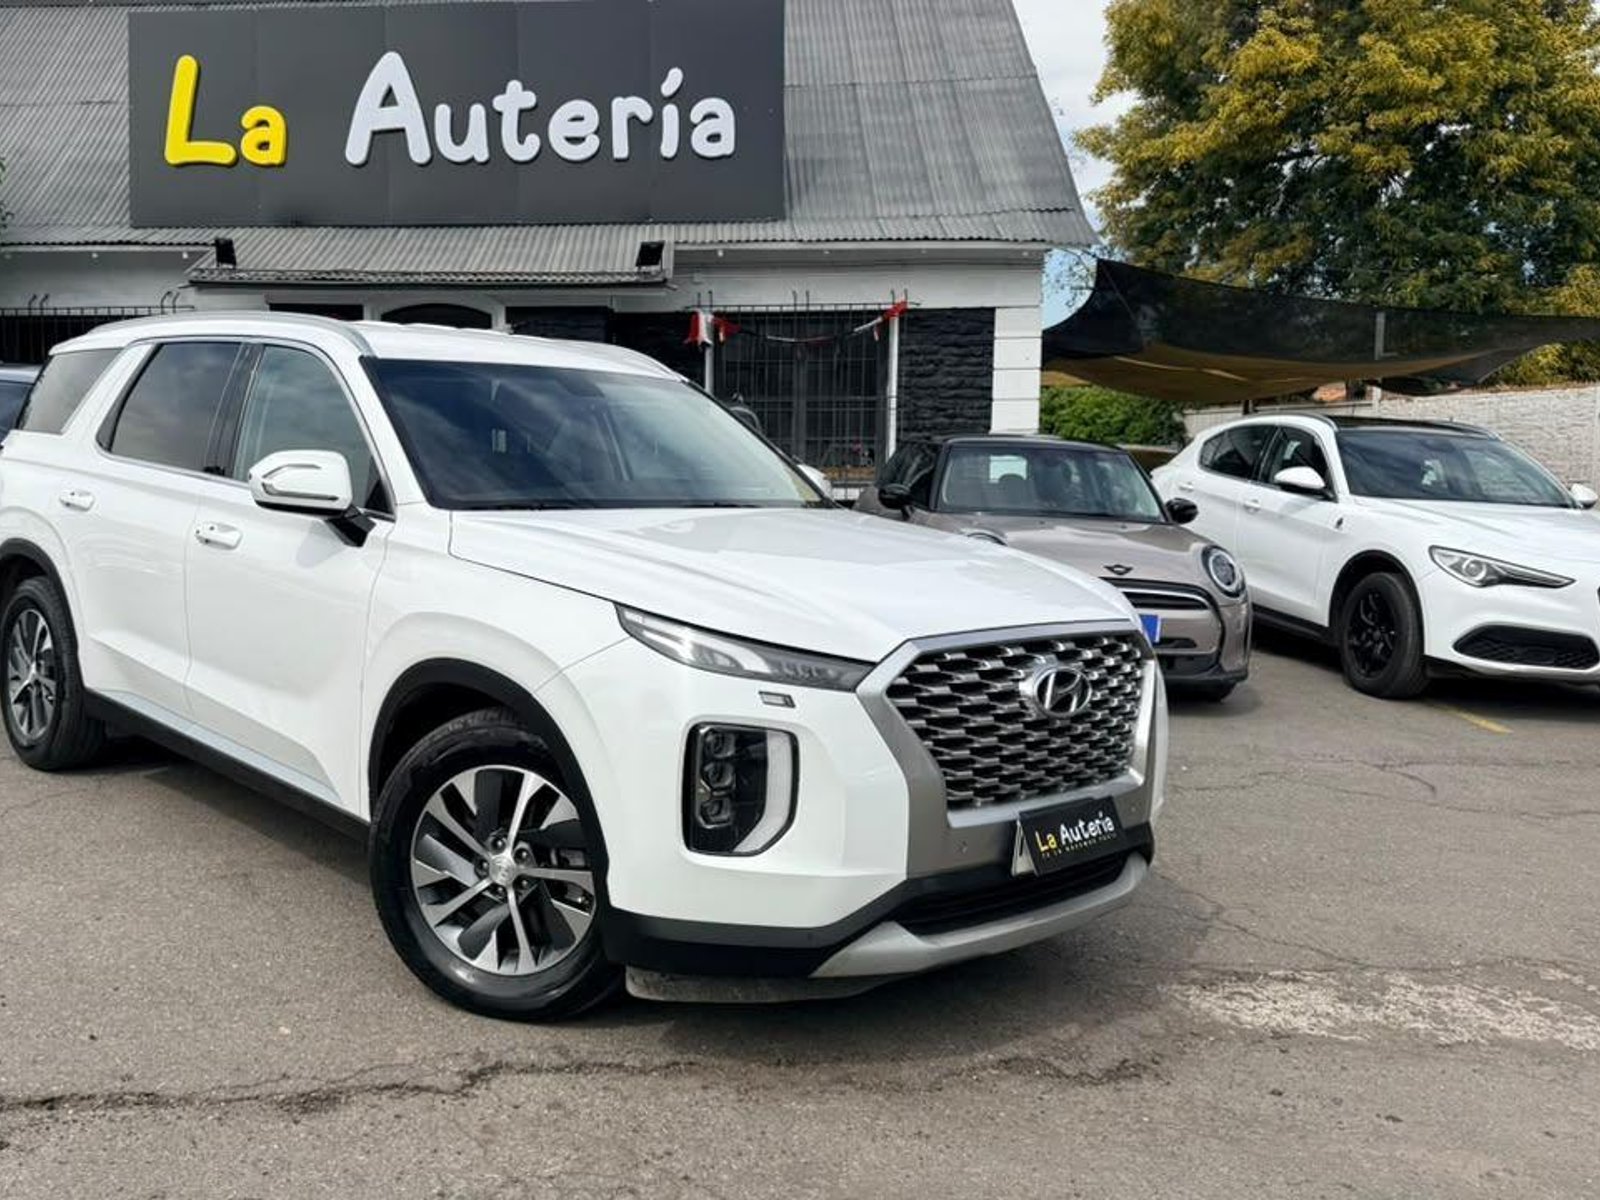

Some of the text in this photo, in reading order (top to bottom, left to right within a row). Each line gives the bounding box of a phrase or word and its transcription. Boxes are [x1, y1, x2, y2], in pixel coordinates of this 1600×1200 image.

[164, 51, 736, 166] La Autería
[1035, 831, 1057, 852] La
